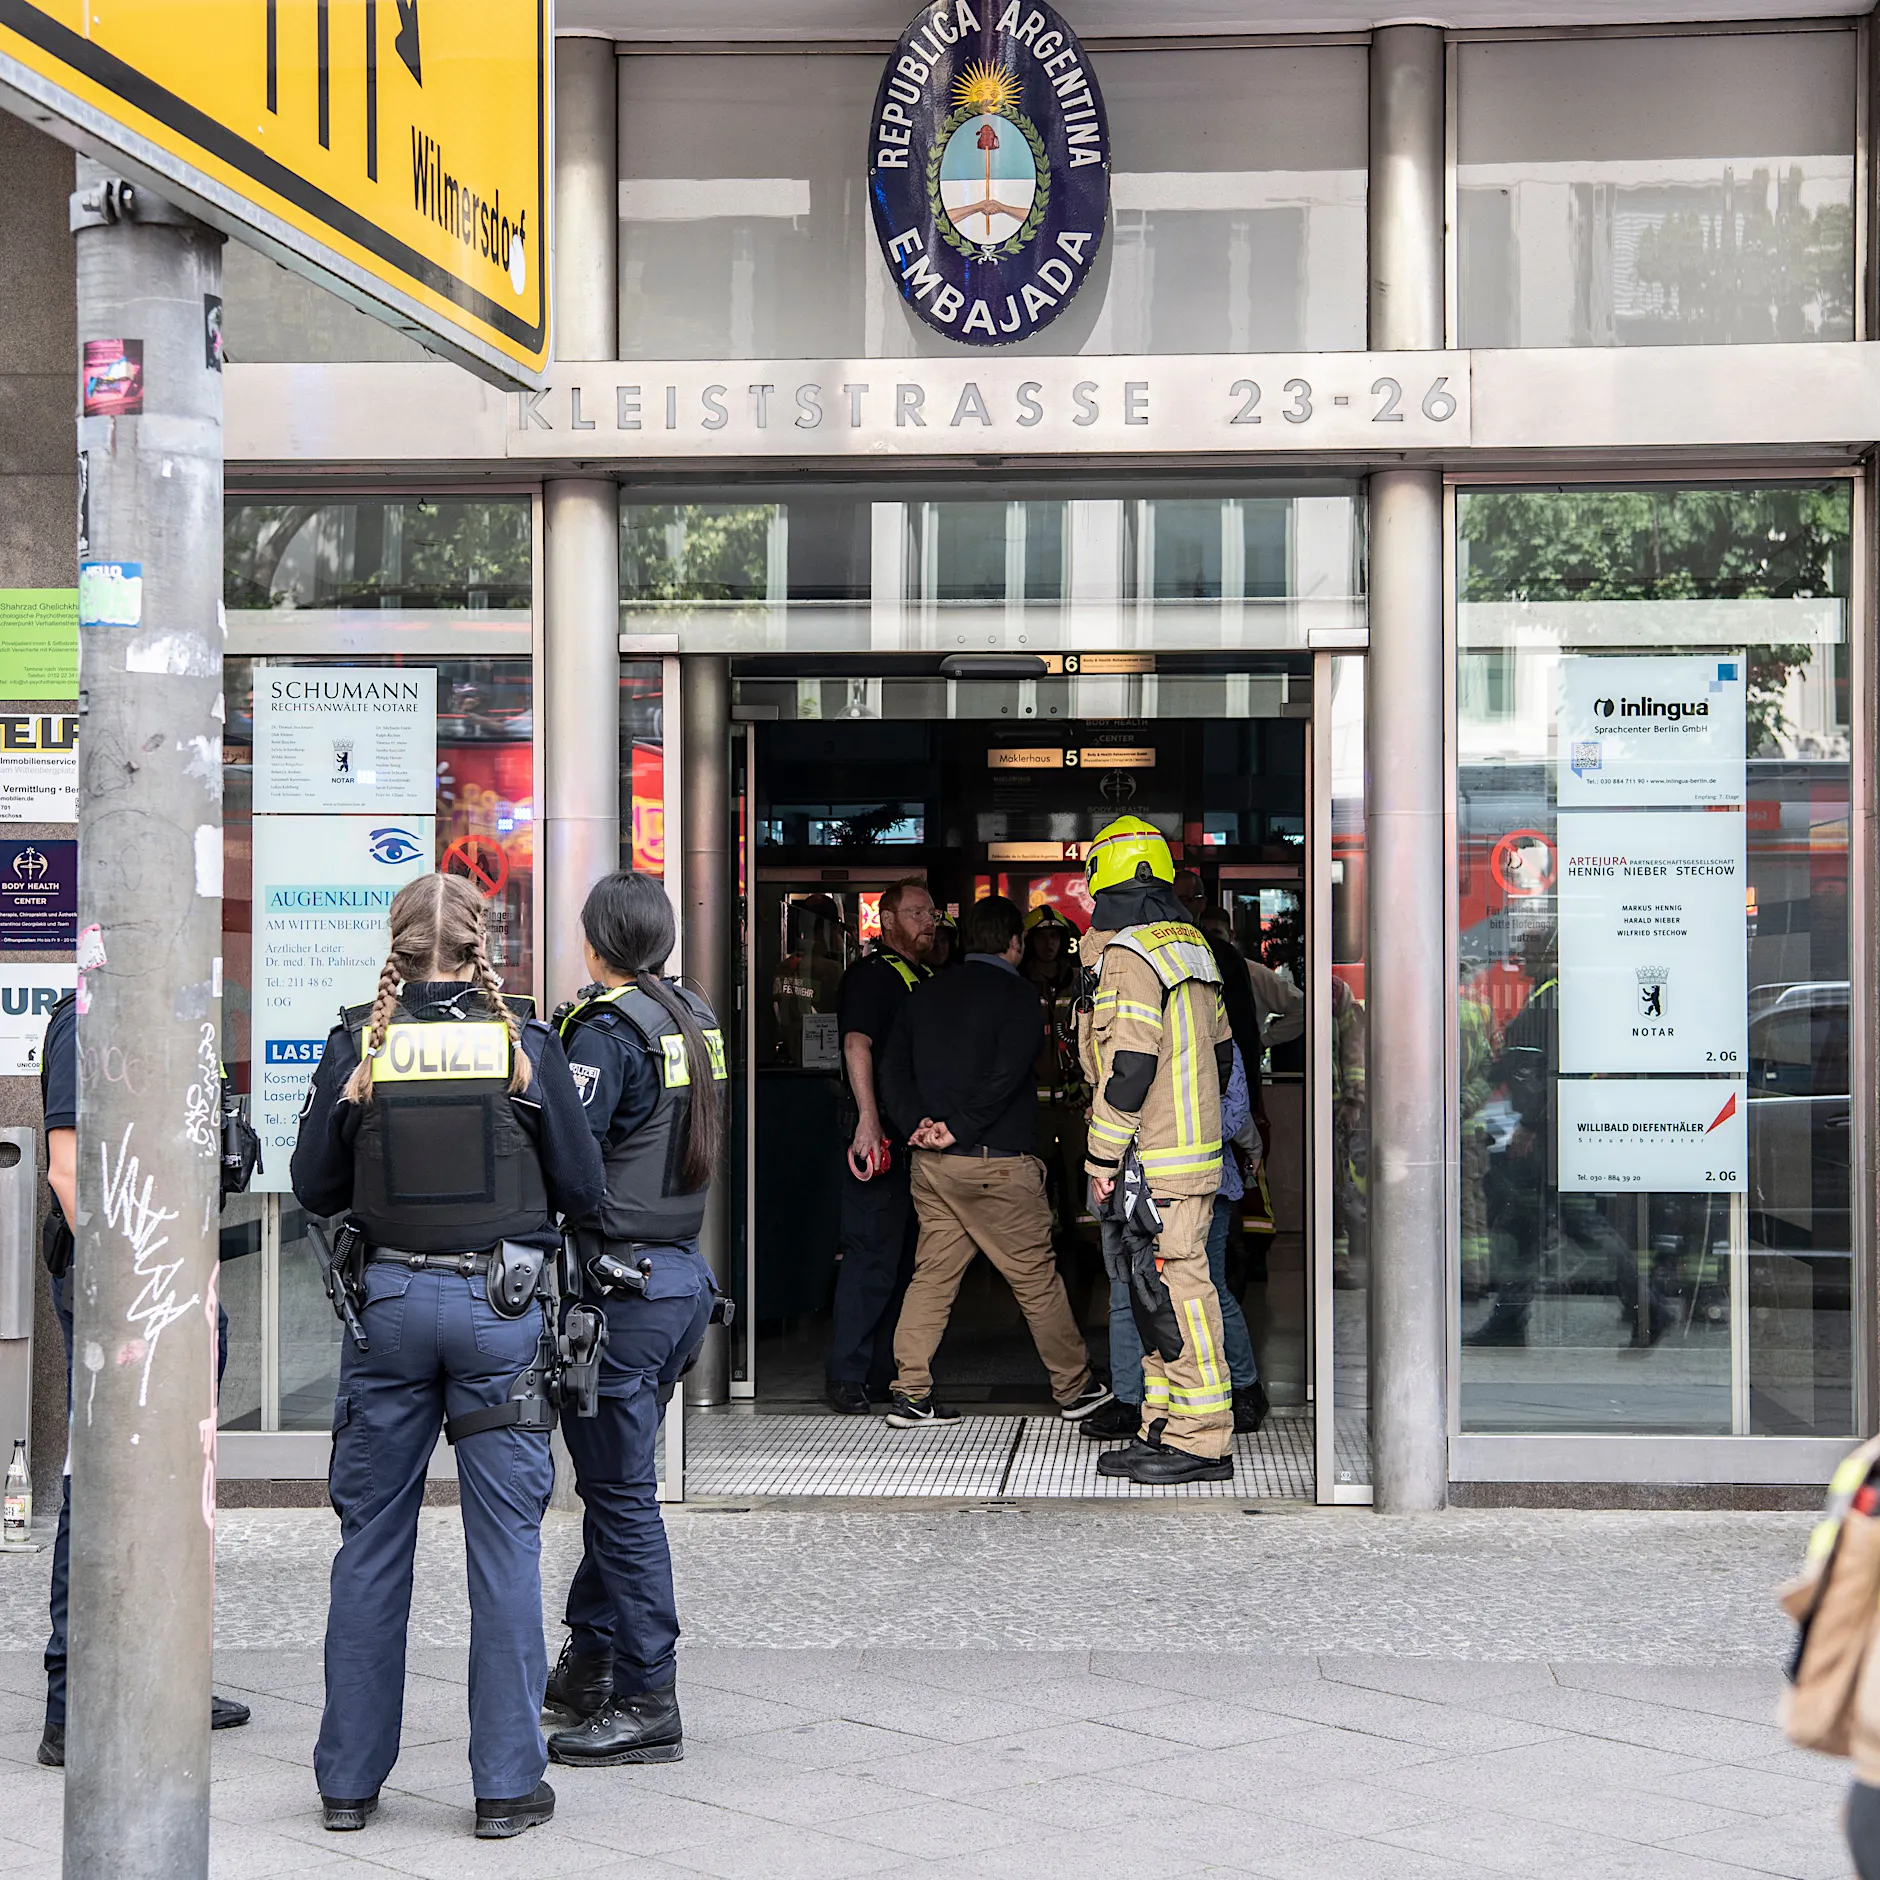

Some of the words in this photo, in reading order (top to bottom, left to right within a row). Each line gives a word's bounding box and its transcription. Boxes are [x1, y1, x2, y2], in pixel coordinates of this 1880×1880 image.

[877, 0, 981, 168] REPUBLICA
[996, 0, 1102, 168] ARGENTINA
[888, 226, 1092, 336] EMBAJADA
[518, 380, 1149, 430] KLEISTSTRASSE
[1229, 377, 1457, 425] 23-26
[1065, 656, 1078, 672] 6
[271, 681, 418, 700] SCHUMANN
[271, 702, 369, 712] RECHTSANWÄLTE
[373, 704, 419, 712] NOTARE
[1621, 697, 1709, 721] inlingua
[1594, 725, 1651, 734] Sprachcenter
[1654, 725, 1680, 733] Berlin
[1682, 724, 1708, 733] GmbH
[1000, 754, 1050, 763] Maklerhaus
[1065, 750, 1078, 766] 5
[15, 766, 76, 776] Wittenbergplatz
[3, 785, 56, 794] Vermittlung
[1065, 843, 1078, 860] 4
[1569, 857, 1627, 866] ARTEJURA
[1568, 867, 1615, 876] HENNIG
[1624, 867, 1667, 876] NIEBER
[1676, 866, 1735, 876] STECHOW
[265, 920, 285, 930] AM
[288, 920, 387, 930] WITTENBERGPL
[1490, 920, 1510, 929] bitte
[1512, 920, 1555, 931] Hofeinga
[265, 943, 311, 954] Ärztlicher
[314, 944, 345, 953] Leiter:
[1068, 937, 1078, 954] 3
[265, 957, 280, 967] Dr.
[283, 957, 305, 967] med.
[308, 957, 324, 967] Th.
[328, 957, 376, 967] Pahlitzsch
[265, 978, 285, 987] Tel.:
[288, 978, 304, 987] 211
[308, 978, 319, 987] 48
[322, 978, 333, 987] 62
[2, 988, 76, 1015] UR
[266, 997, 291, 1007] 1.OG
[1632, 1028, 1674, 1036] NOTAR
[272, 1044, 323, 1060] LASE
[370, 1028, 504, 1074] OLIZEI
[1706, 1052, 1717, 1062] 2.
[1719, 1051, 1737, 1062] OG
[264, 1072, 313, 1084] Kosmet
[264, 1114, 287, 1125] Tel.:
[1577, 1123, 1629, 1132] WILLIBALD
[1632, 1122, 1704, 1132] DIEFENTHÄLER
[264, 1136, 296, 1147] 1.OG
[1705, 1172, 1716, 1181] 2.
[1719, 1171, 1736, 1181] OG
